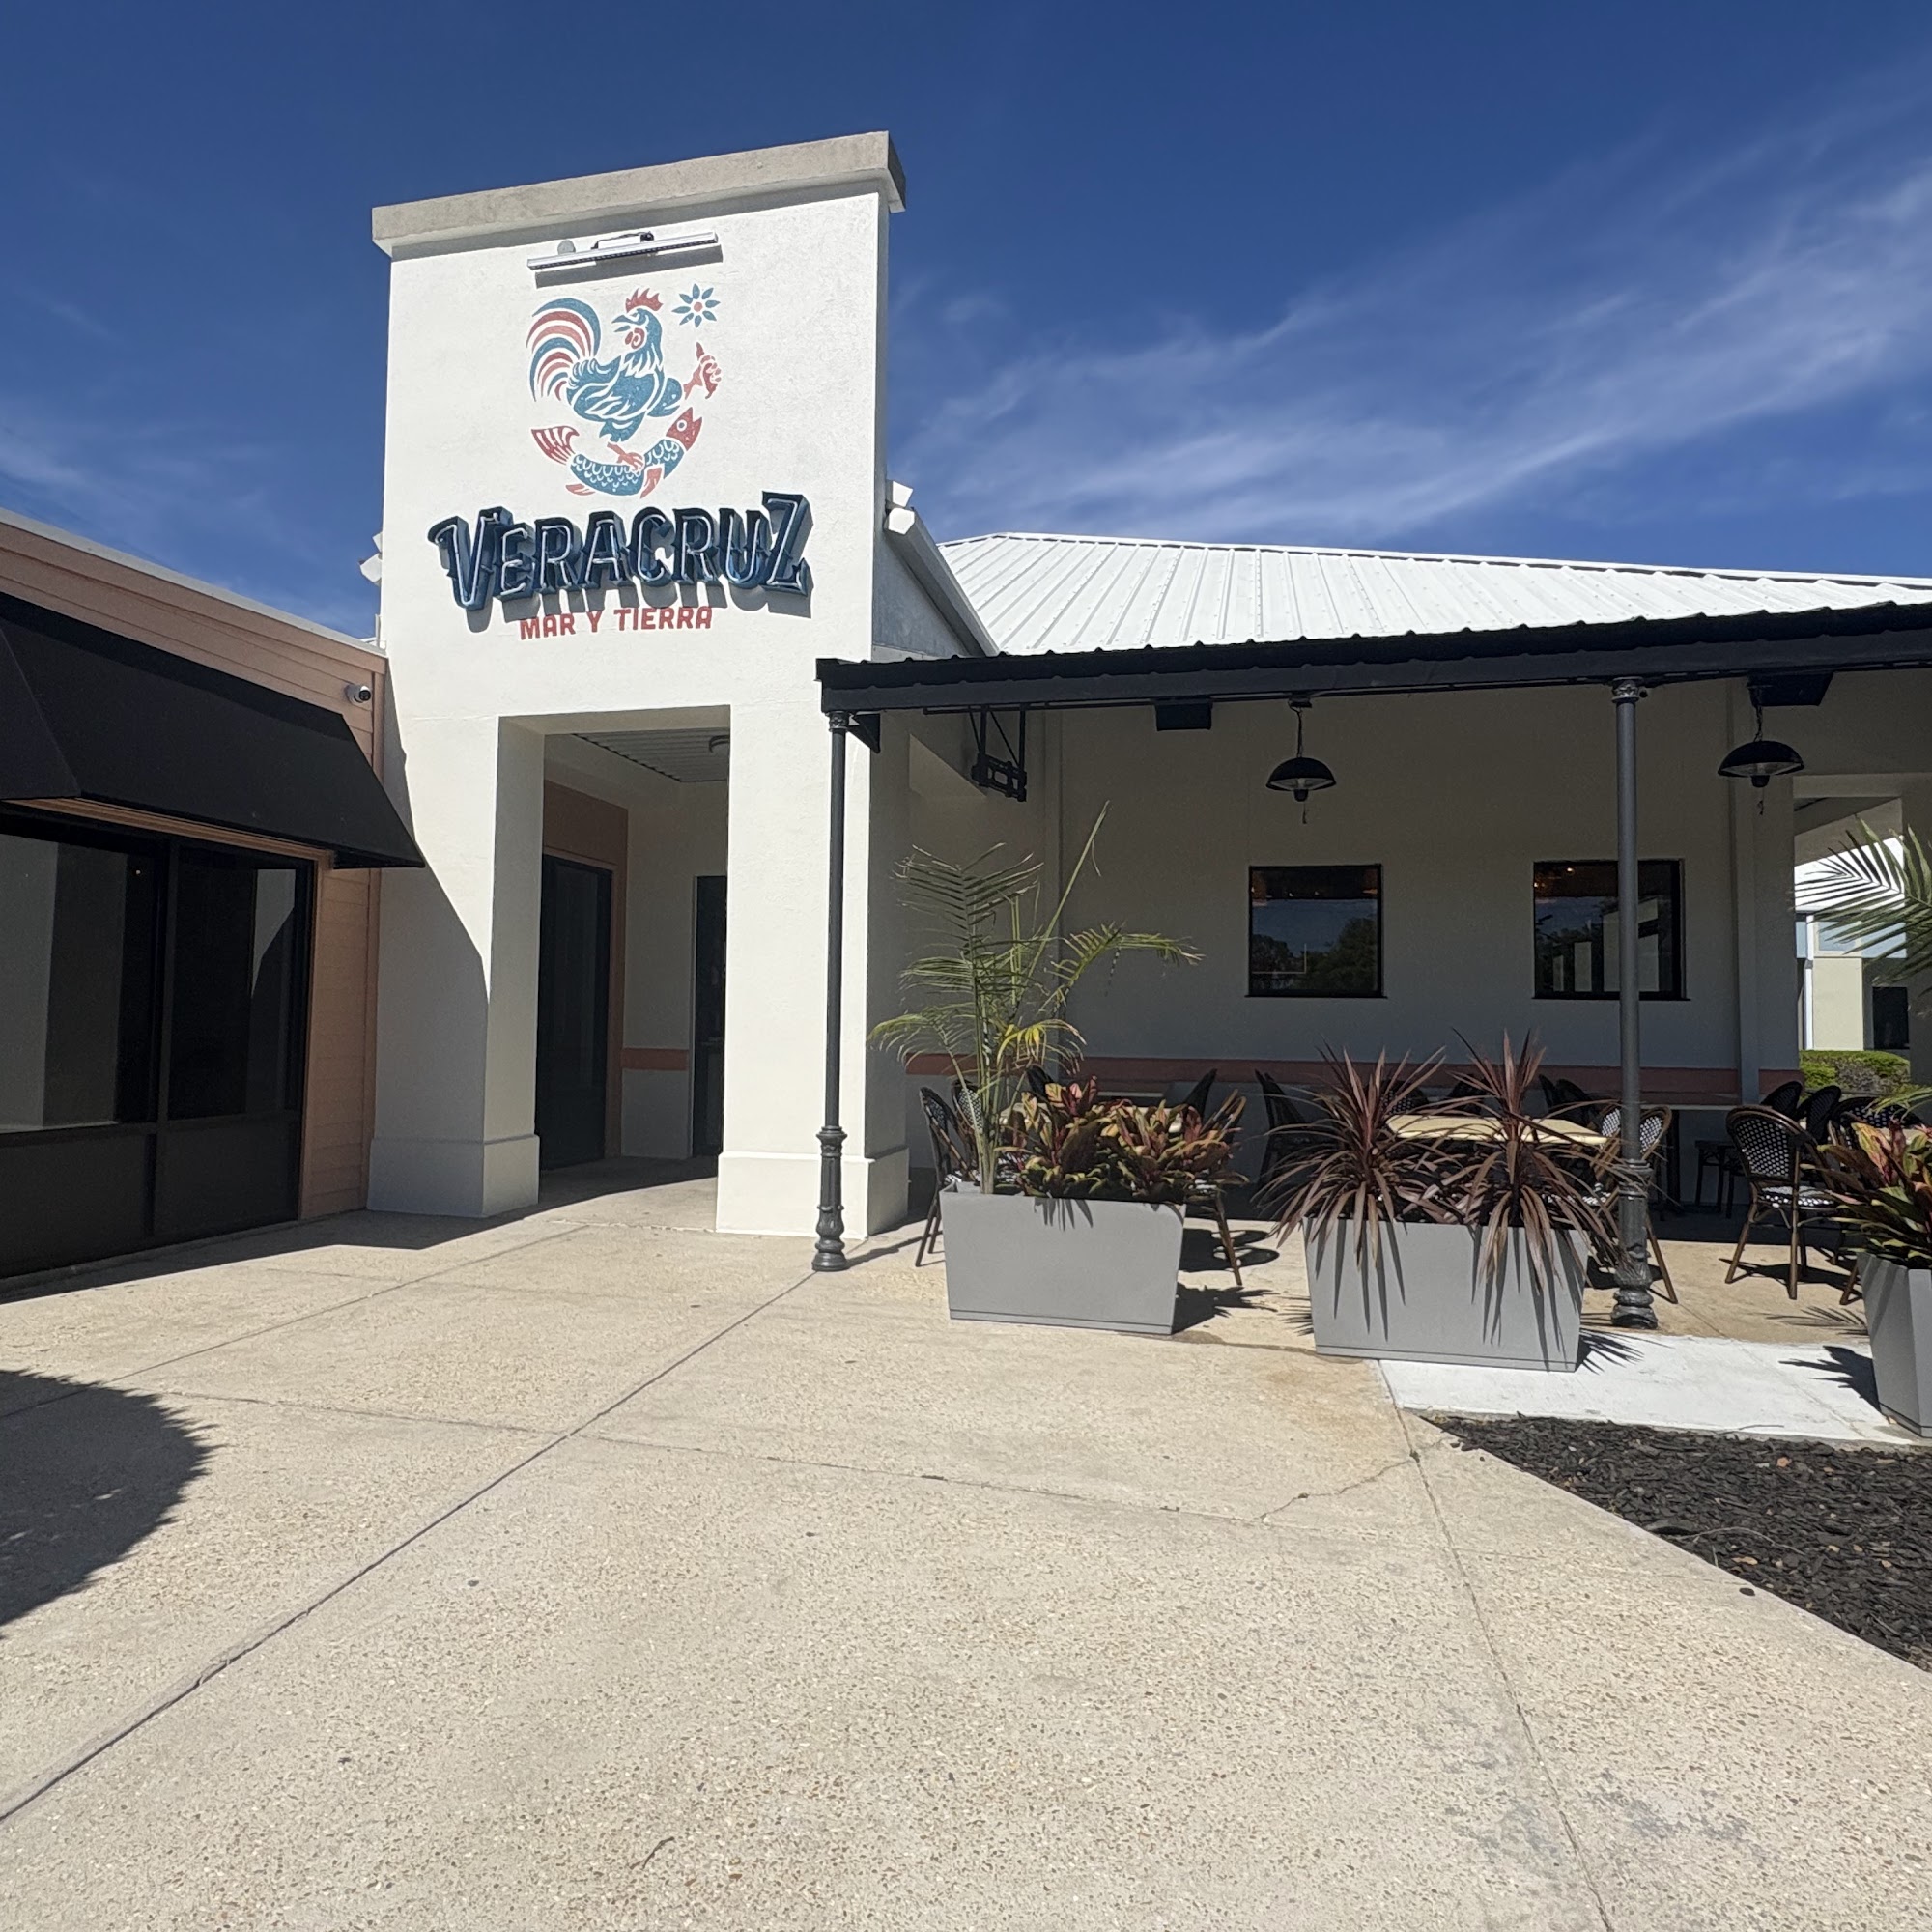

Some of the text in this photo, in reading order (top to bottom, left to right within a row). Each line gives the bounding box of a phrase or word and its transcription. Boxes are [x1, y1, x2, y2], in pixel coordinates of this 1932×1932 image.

[428, 491, 813, 611] VERACRUZ
[520, 606, 713, 639] MAR Y TIERRA
